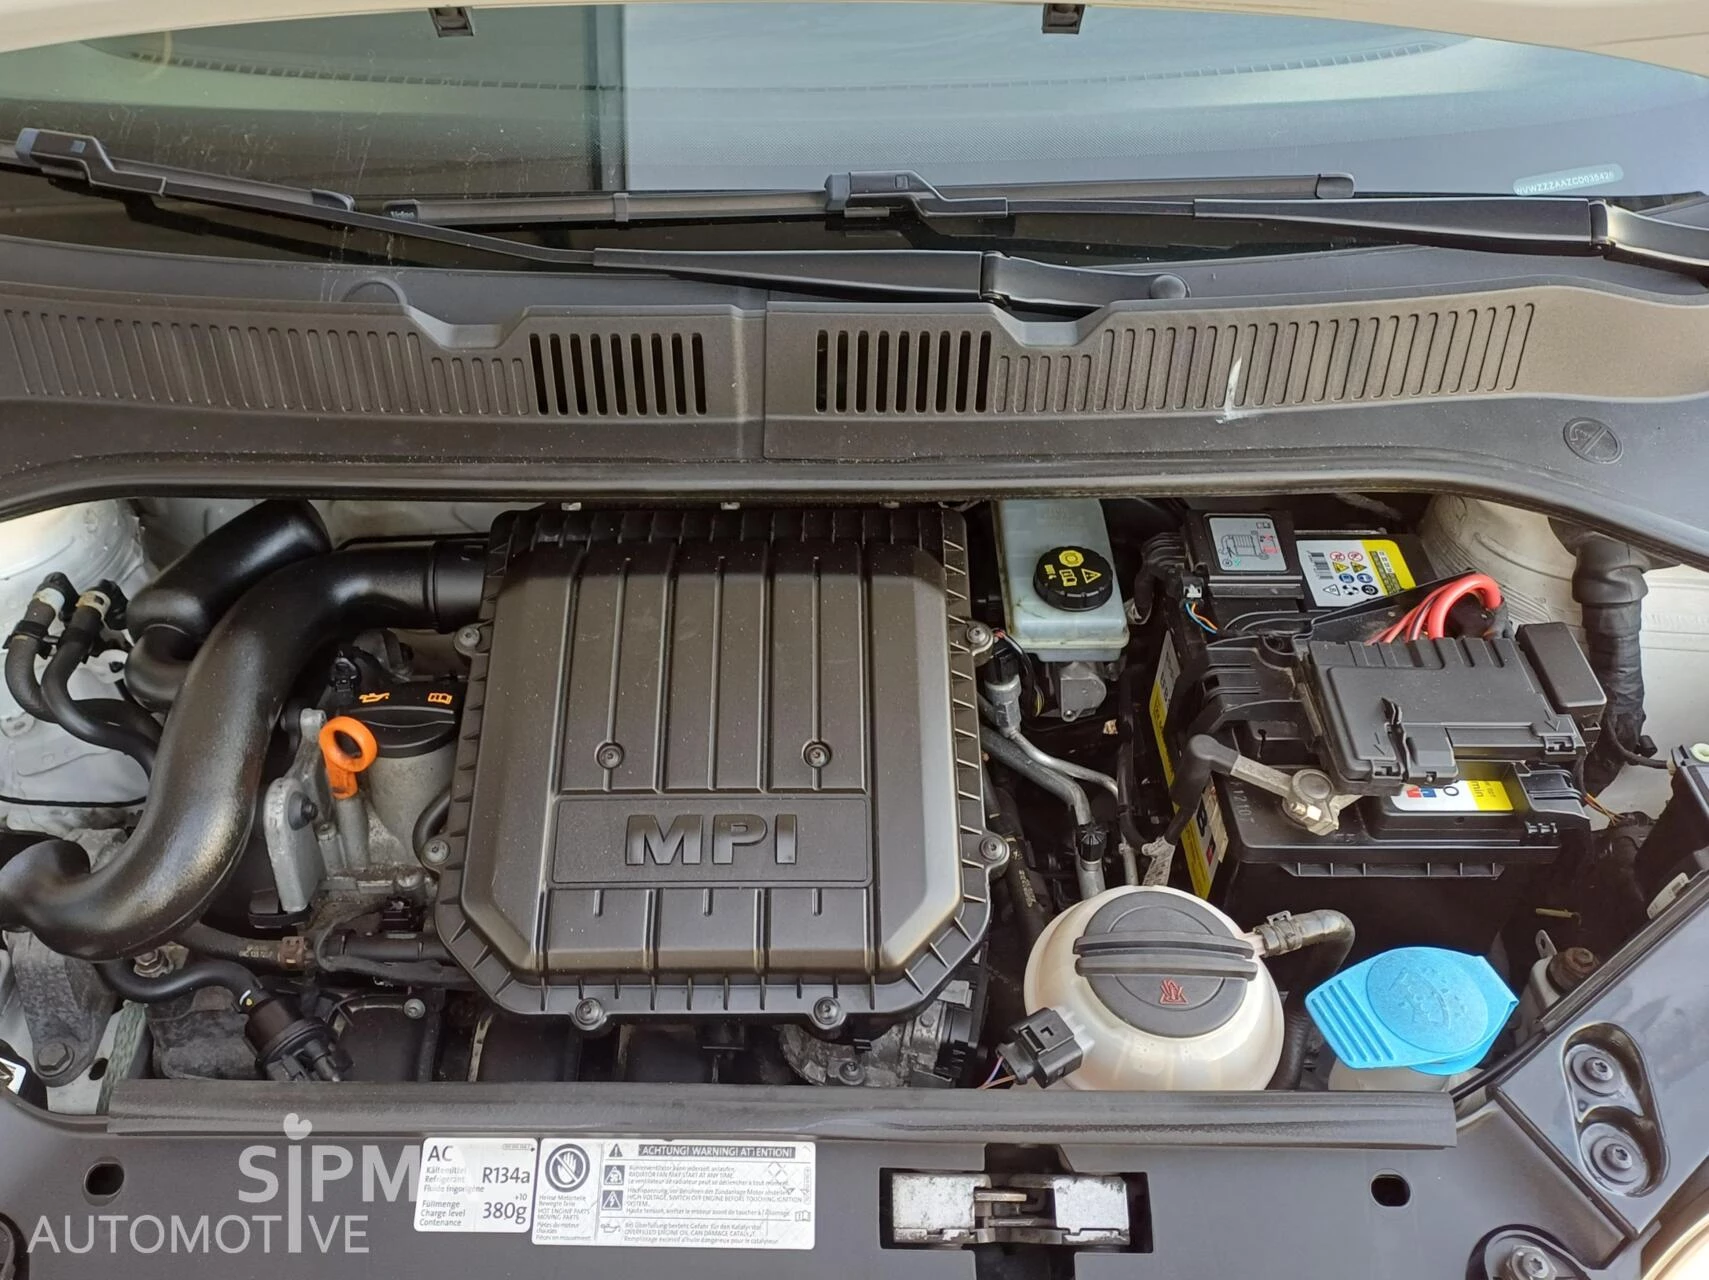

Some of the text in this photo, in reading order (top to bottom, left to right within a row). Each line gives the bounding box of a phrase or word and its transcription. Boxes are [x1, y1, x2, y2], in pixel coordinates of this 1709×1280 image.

[625, 814, 797, 865] MPI
[427, 1144, 454, 1162] AC
[642, 1146, 792, 1158] ACHTUNG! WARNING! ATTENTION!
[482, 1166, 531, 1184] R134a
[420, 1209, 466, 1218] Charge level
[482, 1201, 528, 1225] 380g
[419, 1218, 462, 1227] Contenance
